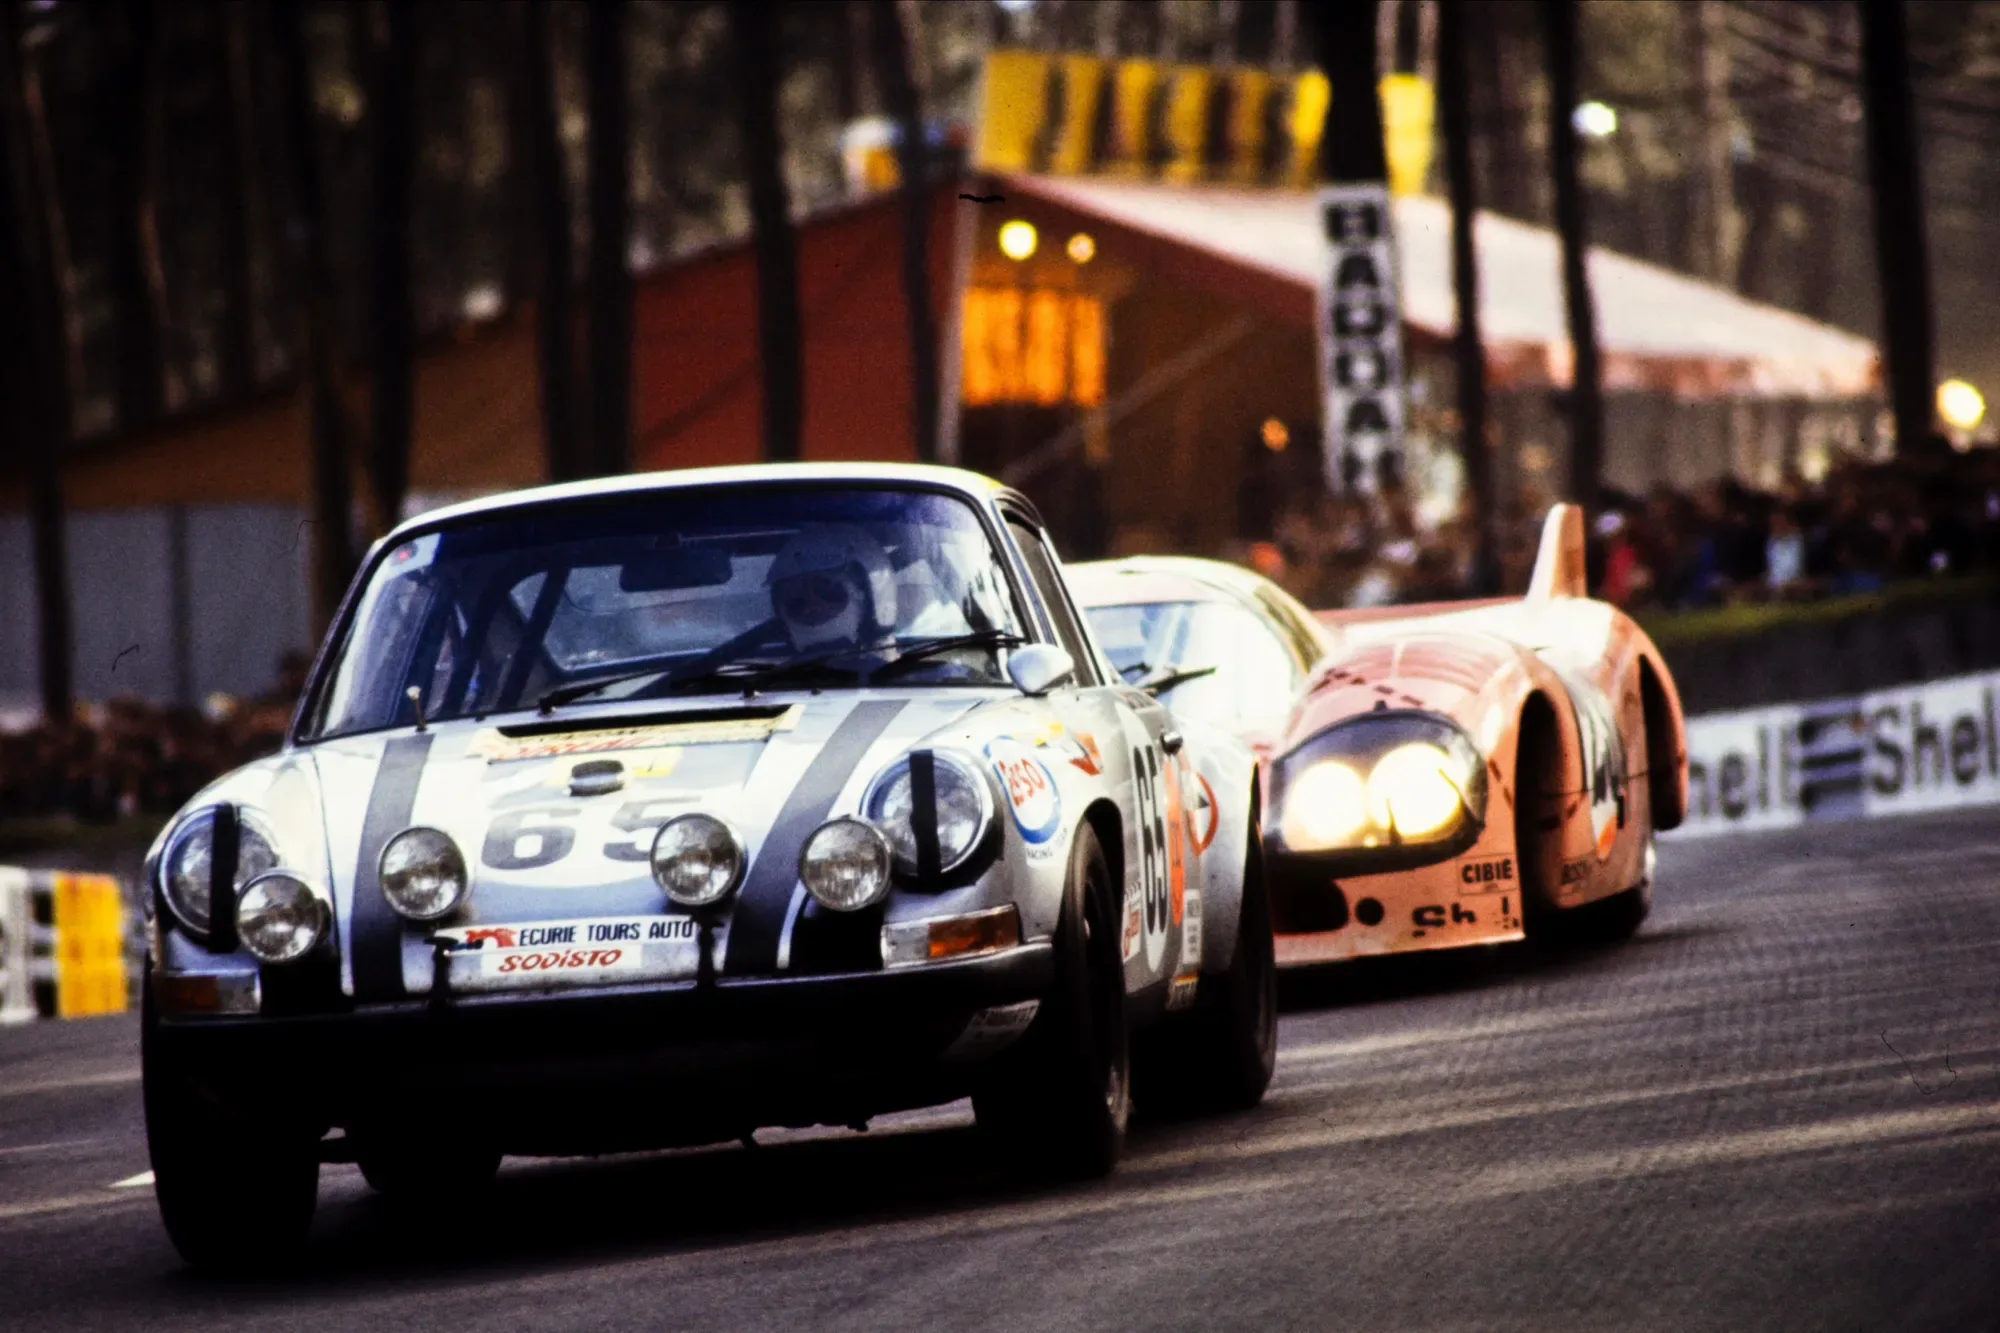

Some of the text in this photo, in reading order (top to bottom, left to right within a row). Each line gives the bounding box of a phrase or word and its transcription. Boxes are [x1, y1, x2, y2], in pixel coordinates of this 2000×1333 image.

[1869, 688, 2000, 796] Shel
[481, 796, 704, 870] 65
[519, 919, 694, 947] ECURIE TOURS AUTO
